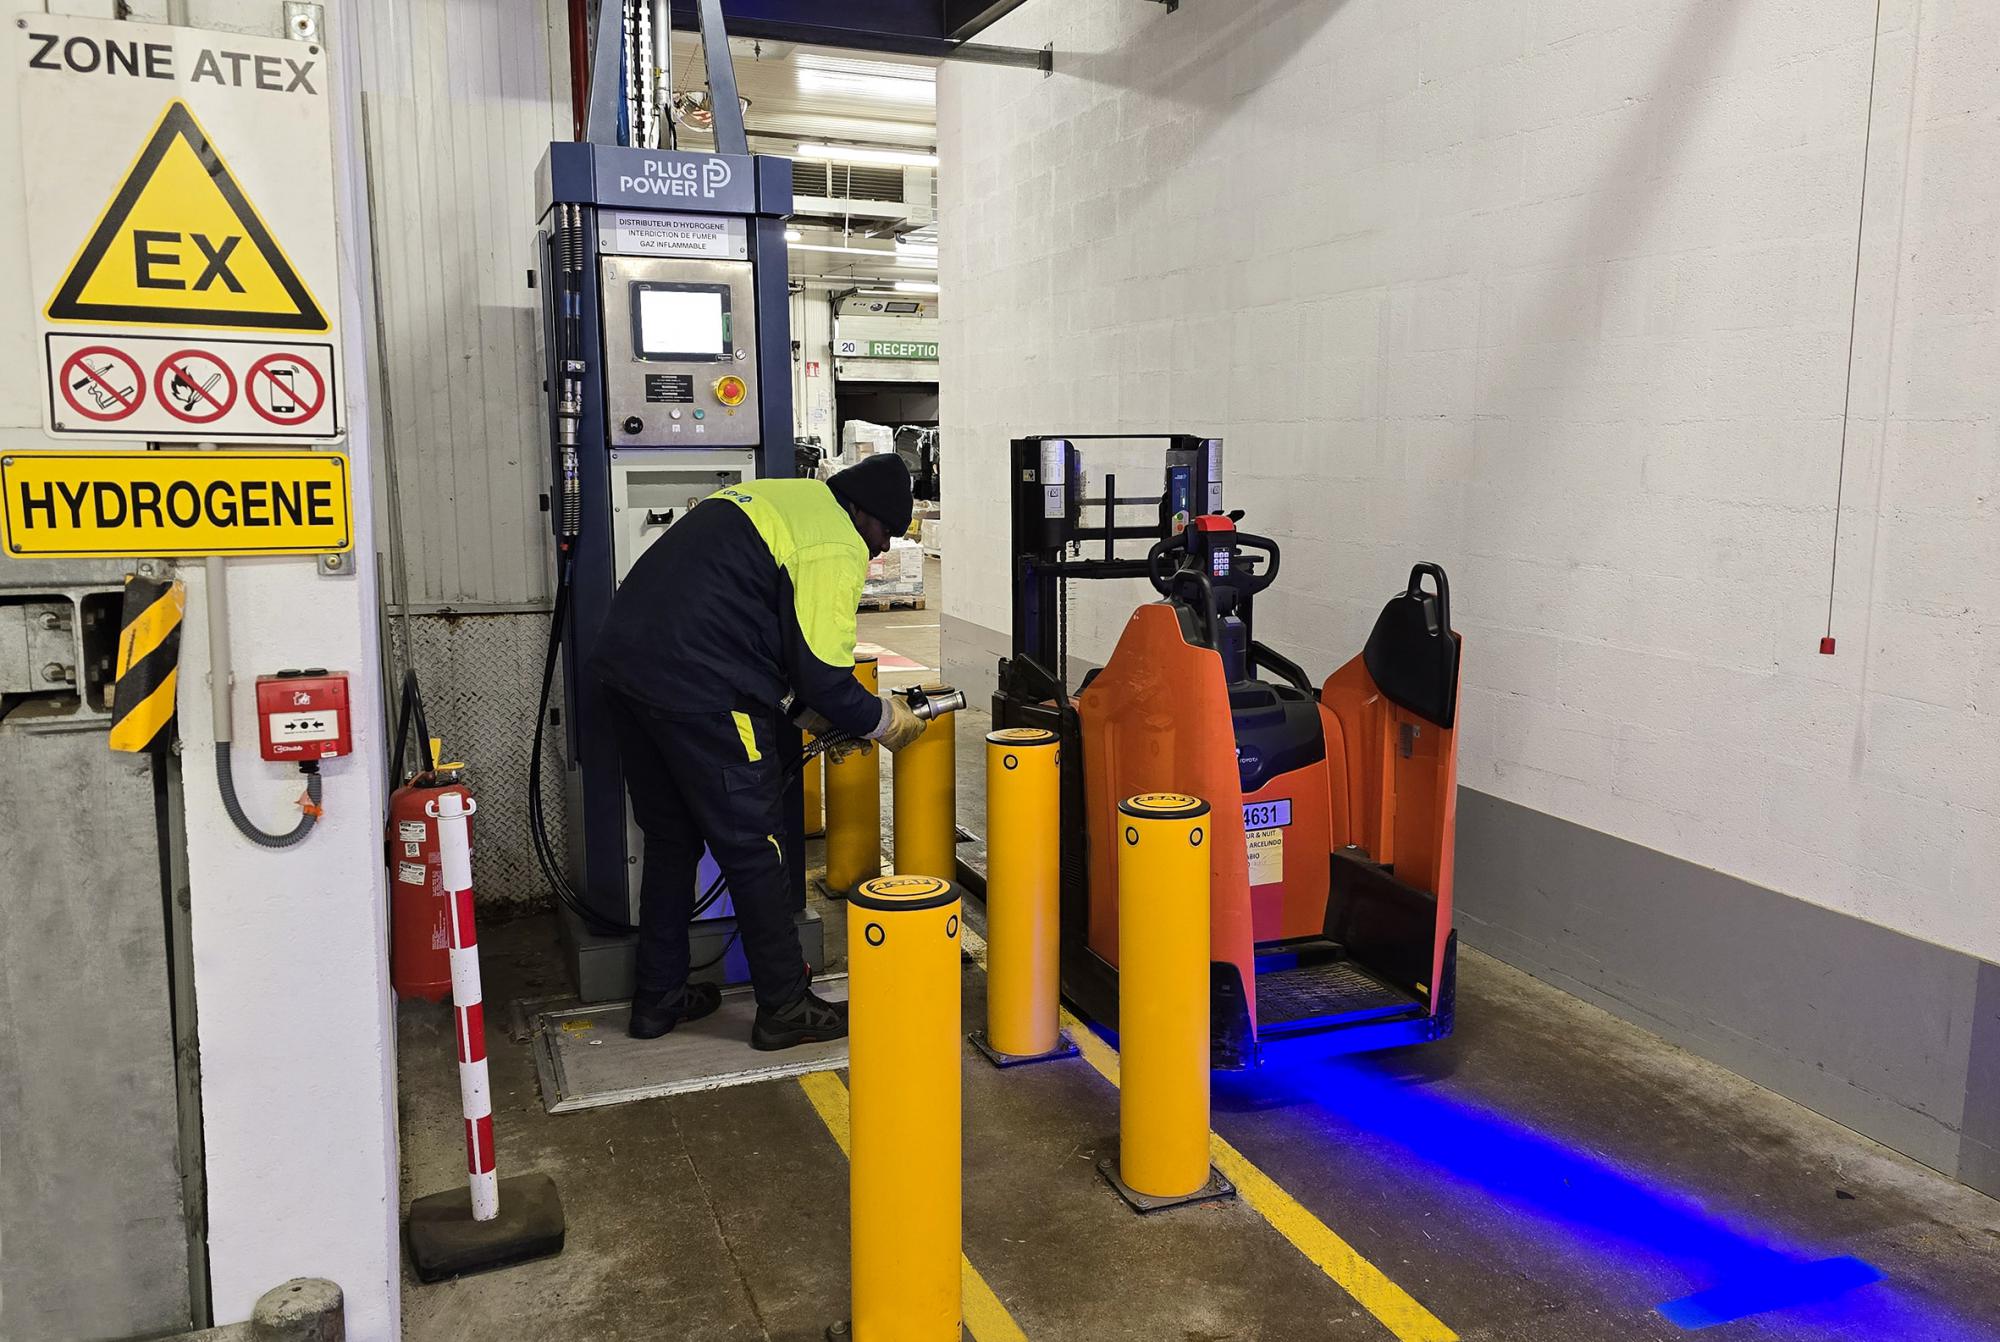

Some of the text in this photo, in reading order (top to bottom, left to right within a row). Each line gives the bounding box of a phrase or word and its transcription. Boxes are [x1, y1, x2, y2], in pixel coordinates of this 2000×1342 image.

[29, 33, 318, 95] ZONE ATEX
[644, 160, 698, 180] PLUG
[620, 175, 698, 197] POWER
[619, 218, 725, 231] DISTRIBUTEUR D'HYDROGENE
[628, 229, 679, 239] INTERDICTION
[692, 233, 717, 241] FUMER
[640, 240, 707, 250] GAZ INFLAMMABLE
[133, 229, 247, 293] EX
[610, 271, 616, 280] 2
[841, 342, 856, 353] 20
[874, 343, 938, 356] RECEPTIO
[20, 480, 334, 529] HYDROGENE
[1262, 829, 1276, 838] NUIT
